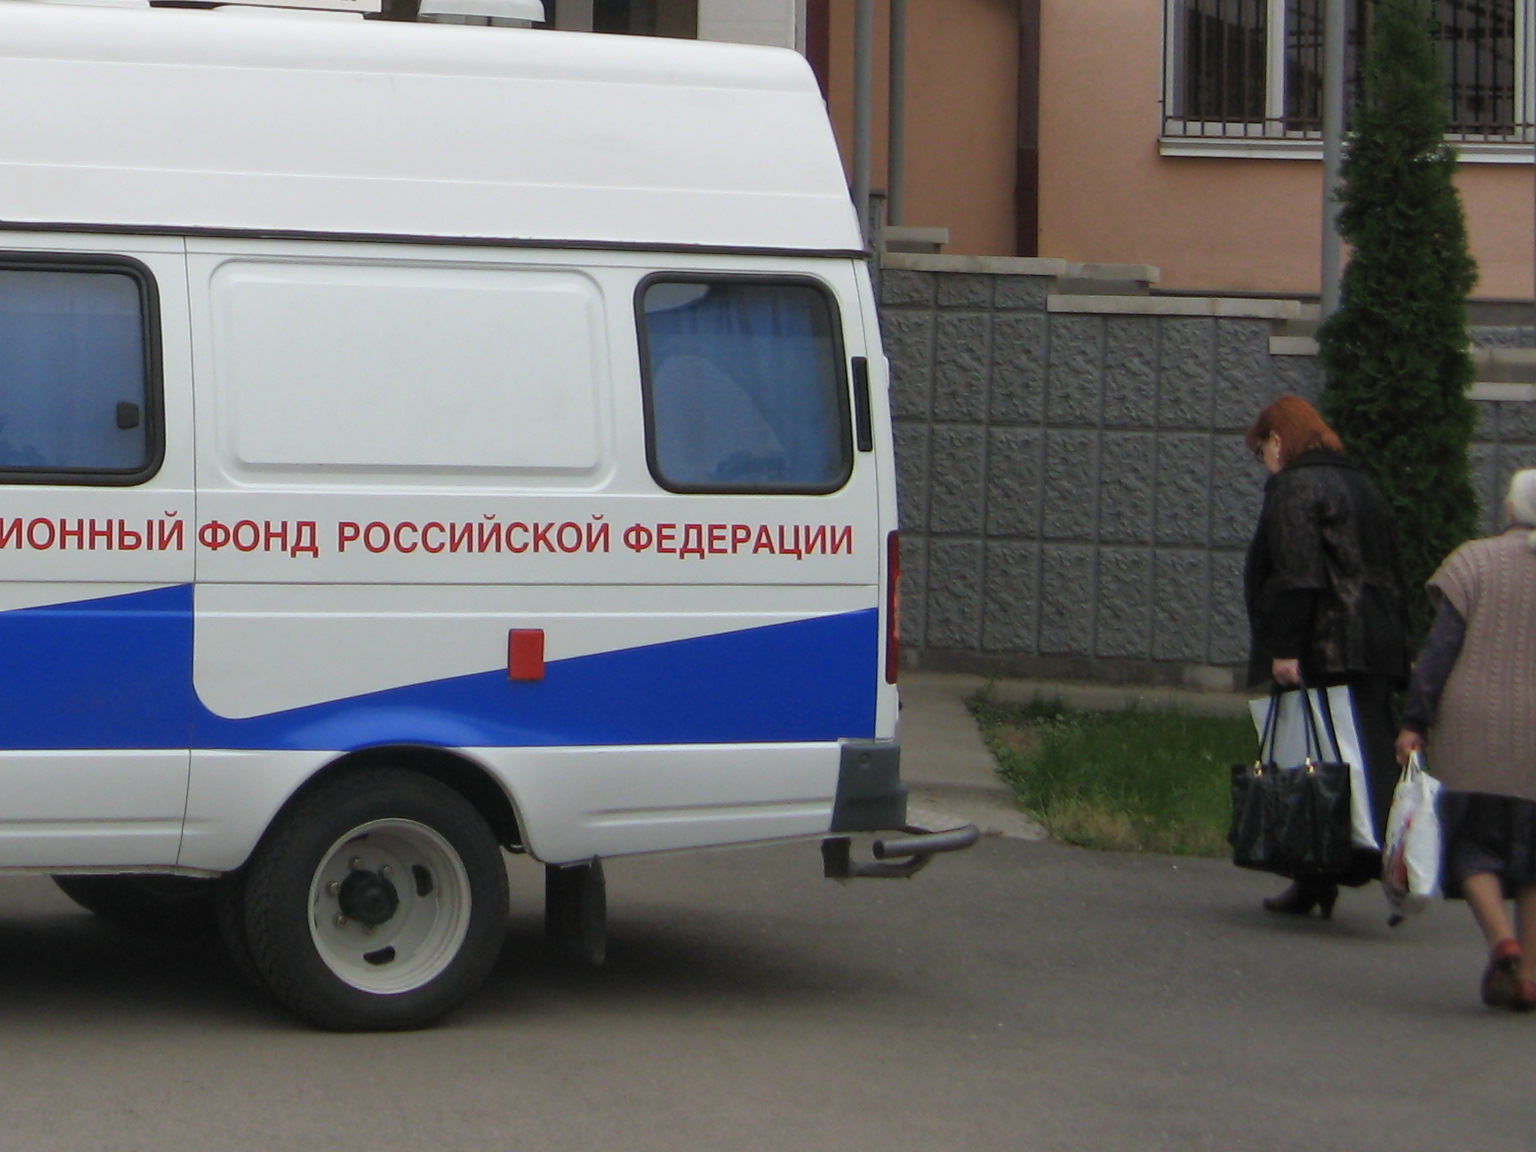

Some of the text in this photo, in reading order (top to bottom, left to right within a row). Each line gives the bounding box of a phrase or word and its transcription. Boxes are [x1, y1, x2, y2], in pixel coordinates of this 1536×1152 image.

[198, 518, 320, 559] ФОНД
[338, 514, 612, 555] РОССИЙСКОЙ
[623, 522, 855, 561] ФЕДЕРАЦИИ
